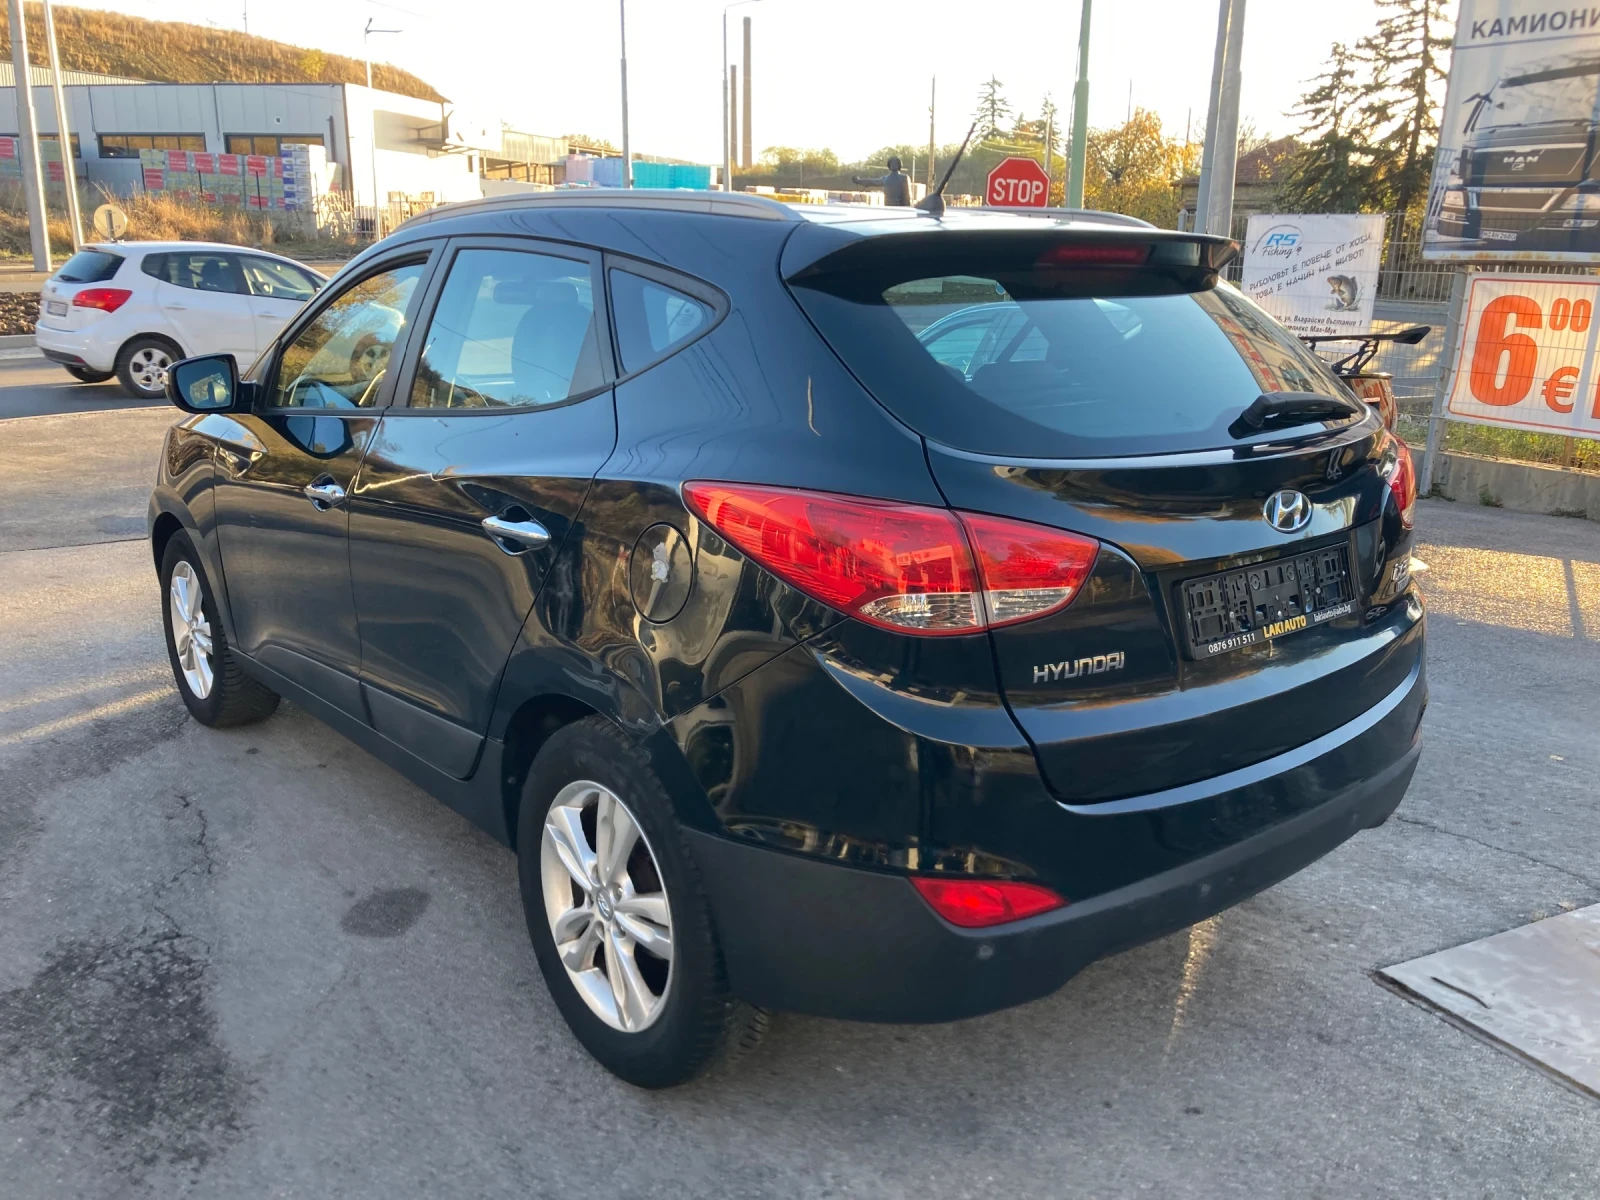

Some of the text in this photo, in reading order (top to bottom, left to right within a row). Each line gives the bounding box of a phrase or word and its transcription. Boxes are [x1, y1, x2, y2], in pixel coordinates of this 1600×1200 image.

[1471, 8, 1600, 39] КАМИОНИ
[1503, 155, 1539, 163] MAN
[993, 177, 1044, 203] STOP
[1262, 245, 1293, 259] Fishing
[1266, 234, 1299, 246] RS
[1250, 268, 1289, 290] РИБОЛОВЪТ
[1292, 264, 1298, 273] Е
[1302, 250, 1332, 269] ПОВЕЧЕ
[1335, 244, 1346, 254] ОТ
[1255, 289, 1274, 299] ТОВА
[1277, 282, 1283, 291] Е
[1286, 270, 1315, 287] НАЧИН
[1319, 263, 1332, 272] НА
[1208, 633, 1255, 654] 0876 911 511
[1033, 651, 1125, 683] HYUNDAI
